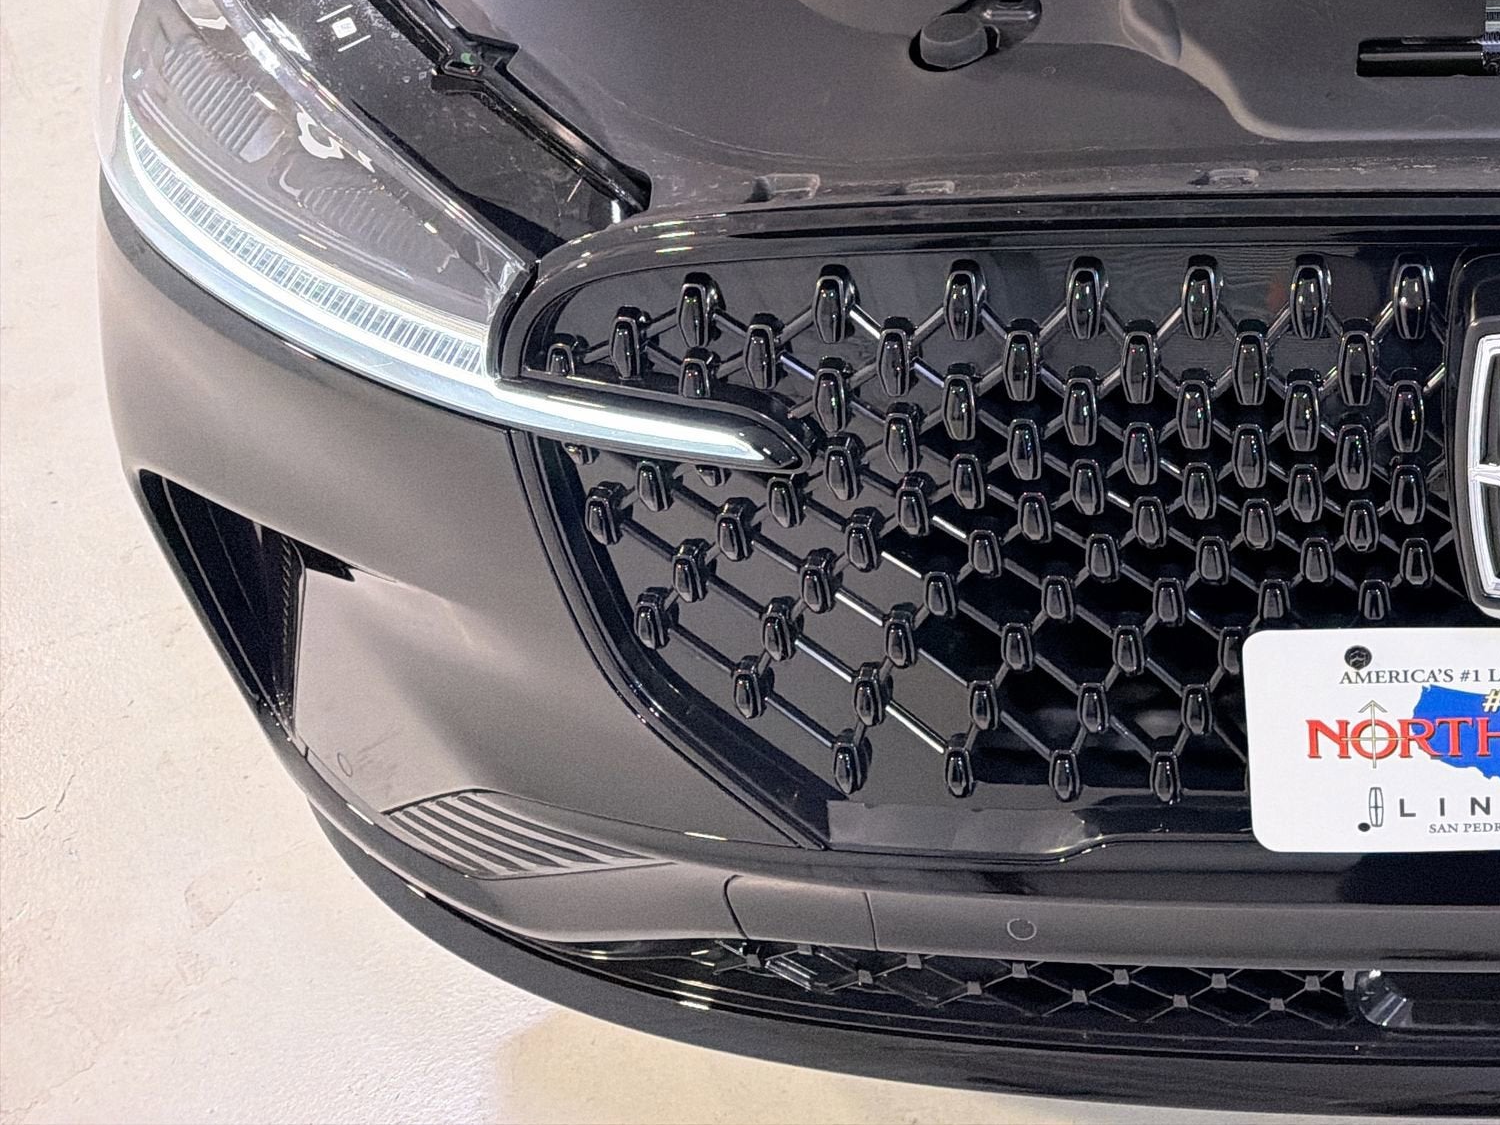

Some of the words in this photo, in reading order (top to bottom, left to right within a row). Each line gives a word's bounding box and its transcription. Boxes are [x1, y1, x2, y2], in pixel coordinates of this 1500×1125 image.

[1339, 668, 1454, 685] AMERICA'S
[1460, 668, 1481, 683] #1
[1428, 823, 1459, 834] SAN
